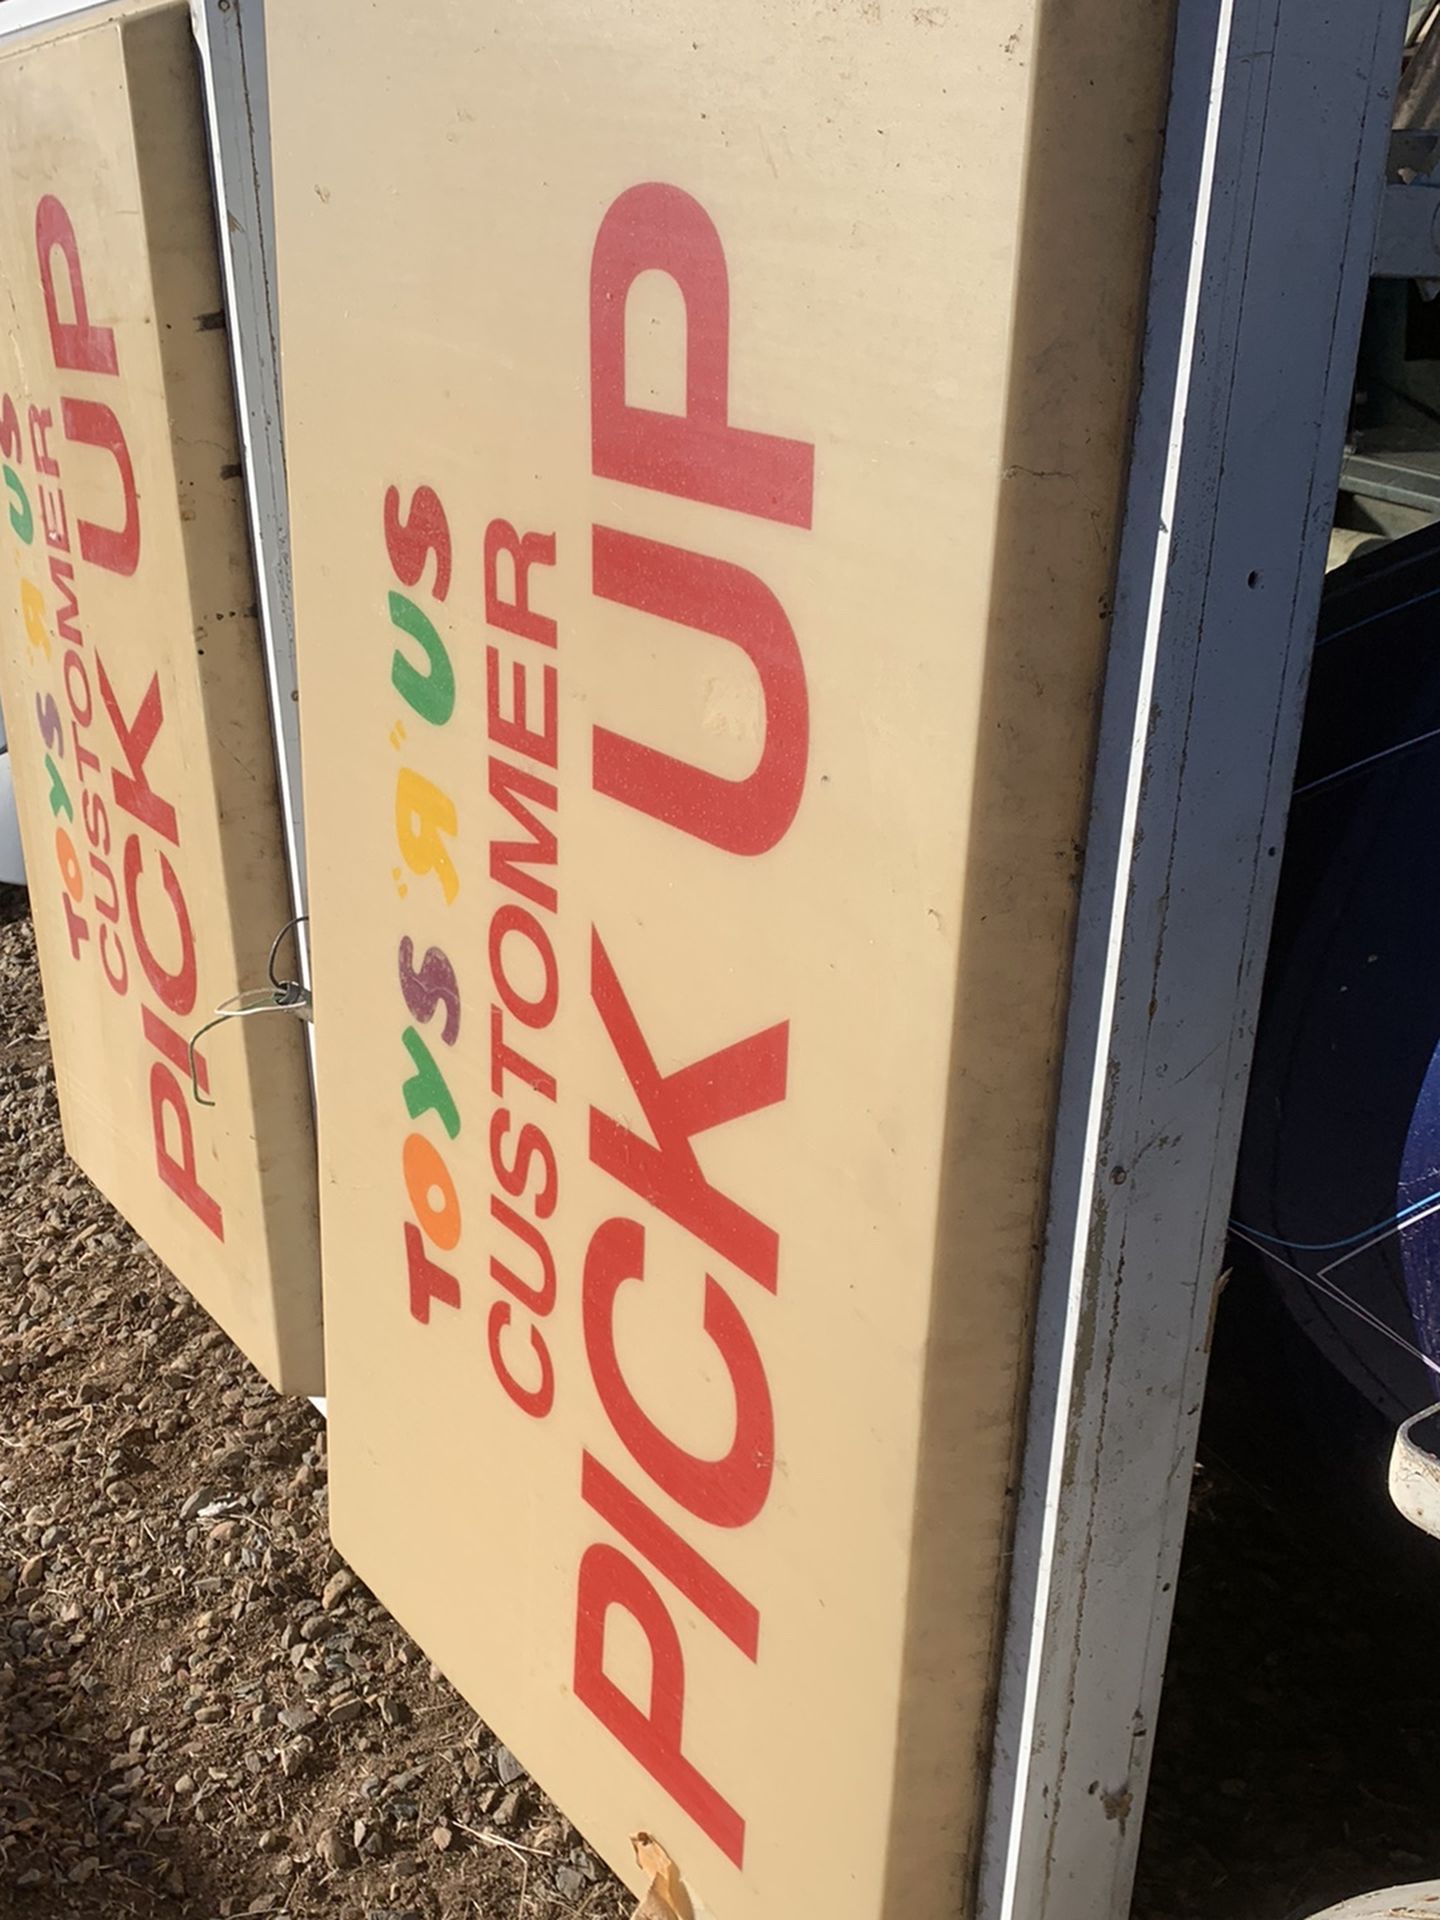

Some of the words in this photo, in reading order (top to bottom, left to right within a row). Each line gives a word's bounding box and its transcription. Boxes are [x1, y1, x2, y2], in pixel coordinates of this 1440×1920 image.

[0, 393, 34, 545] US
[36, 194, 141, 578] UP
[384, 484, 456, 726] US
[590, 181, 815, 857] UP
[29, 403, 128, 997] CUSTOMER
[37, 691, 89, 960] TOYS
[95, 646, 225, 1244] PICK
[399, 934, 462, 1326] TOYS
[484, 517, 559, 1419] CUSTOMER
[572, 922, 790, 1871] PICK
